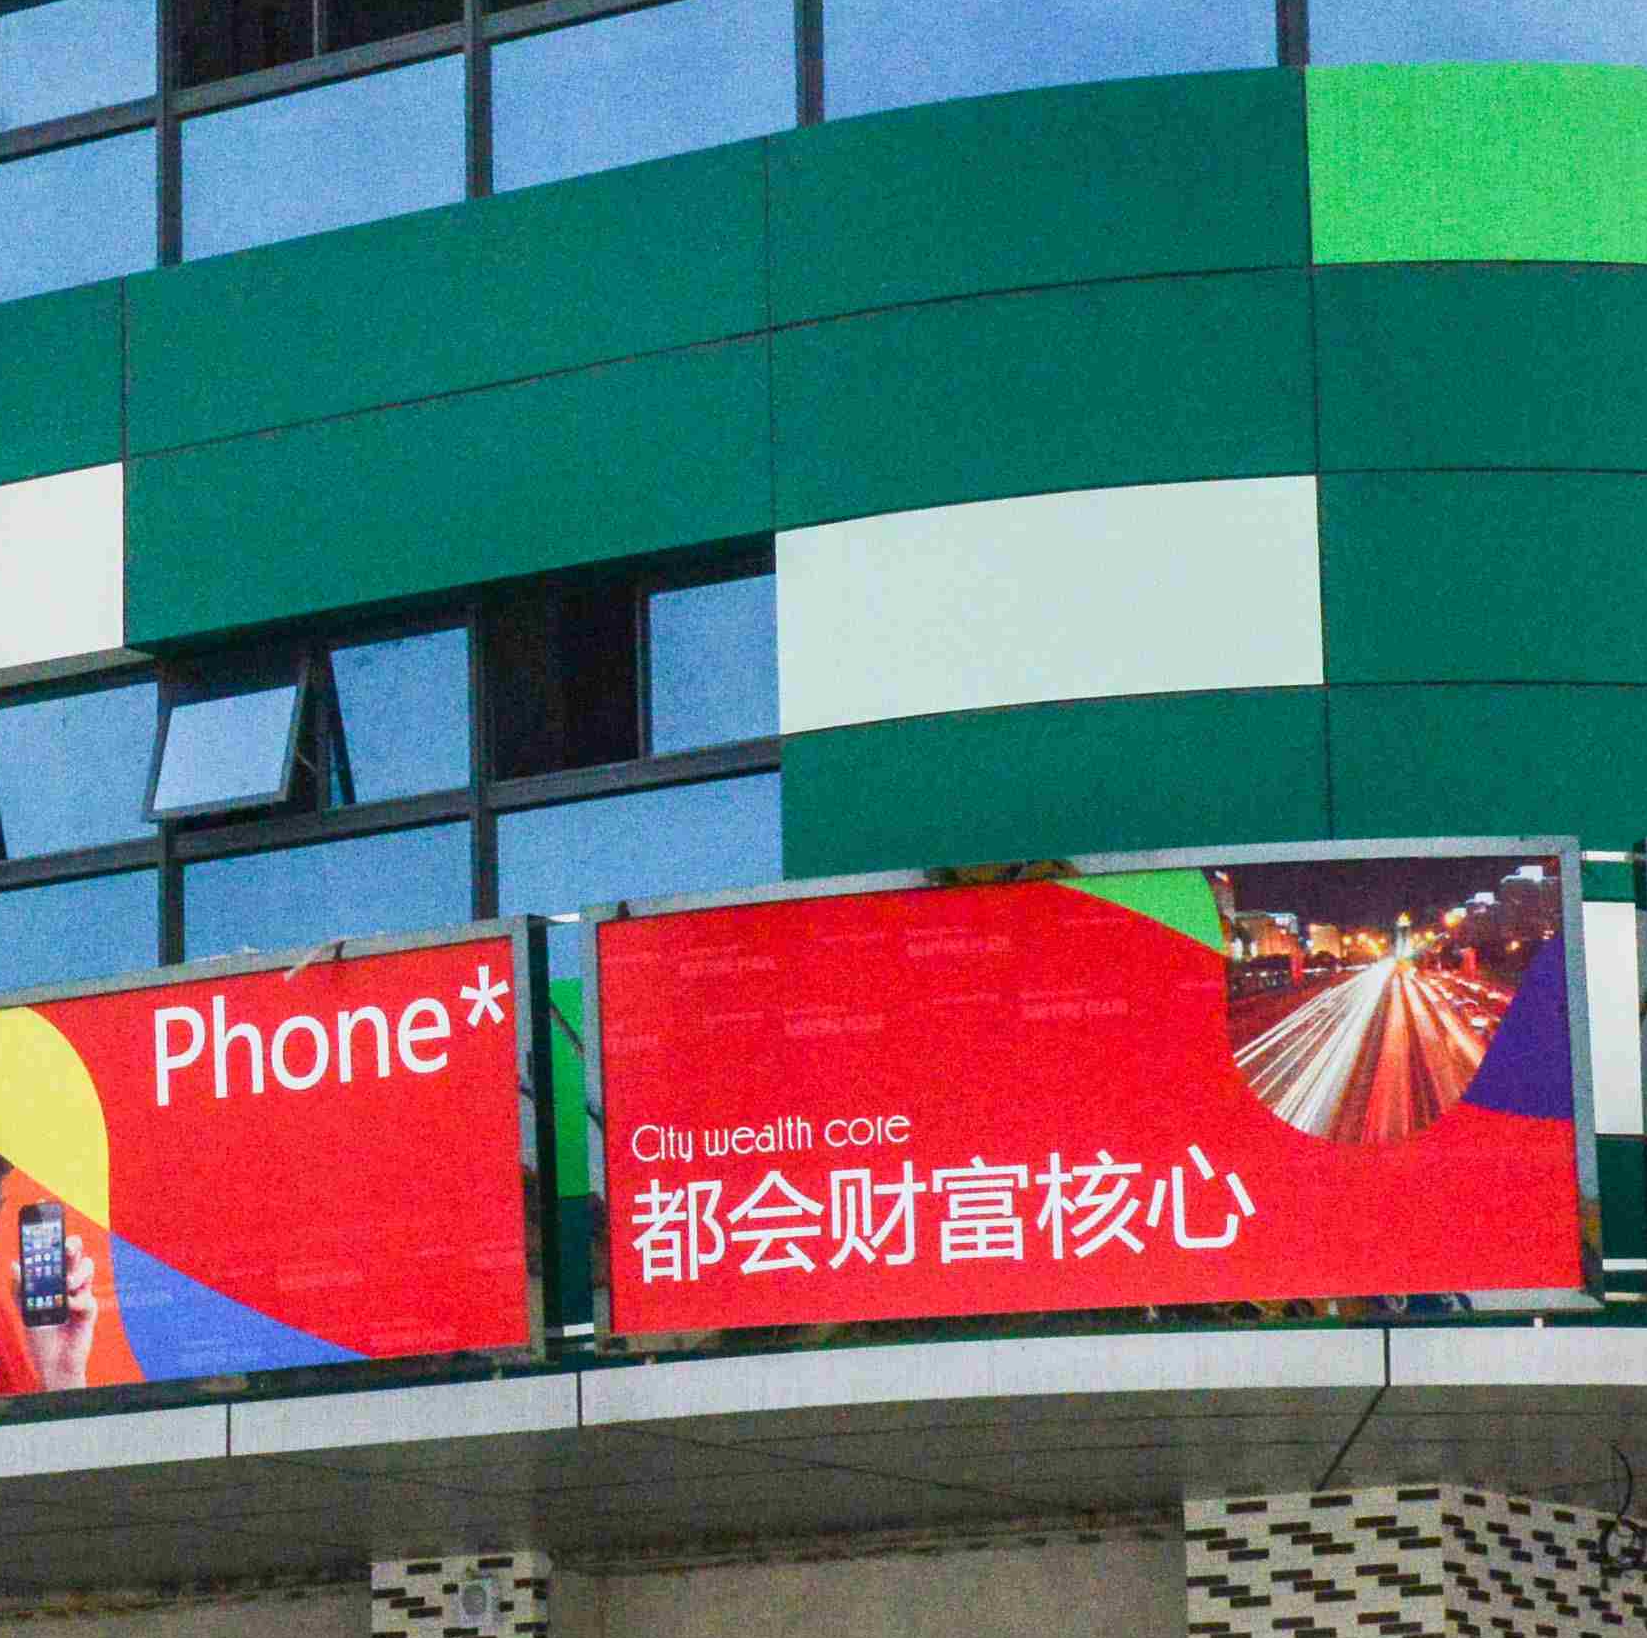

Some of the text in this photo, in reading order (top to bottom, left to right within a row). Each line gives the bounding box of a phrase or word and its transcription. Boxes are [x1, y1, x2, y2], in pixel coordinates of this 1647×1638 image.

[631, 1115, 912, 1164] City wealth core
[631, 1143, 1257, 1284] 都会财富核心
